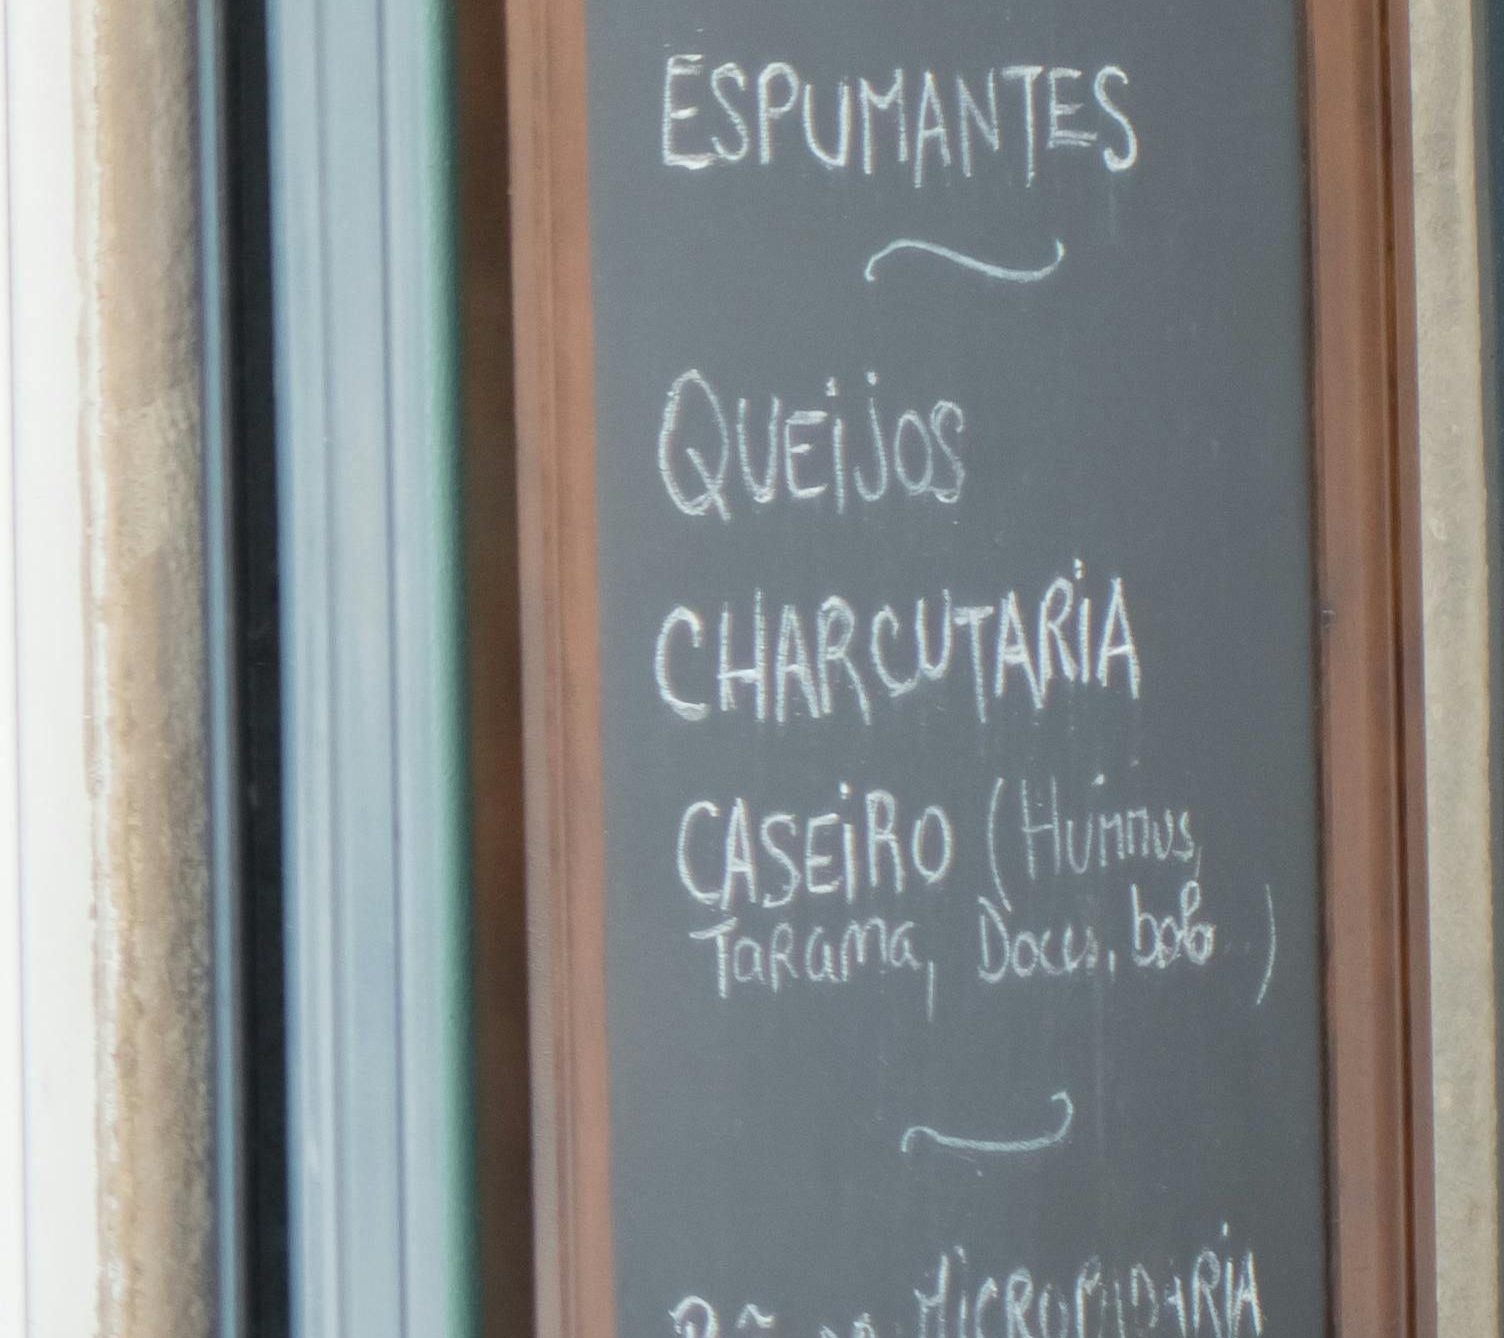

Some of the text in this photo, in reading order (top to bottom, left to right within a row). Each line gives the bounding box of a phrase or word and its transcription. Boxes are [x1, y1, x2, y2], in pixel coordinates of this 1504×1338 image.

[663, 54, 1139, 189] ESPUMANTES
[659, 368, 966, 521] QUEIJOS
[654, 558, 1141, 725] CHARCUTARIA
[677, 781, 954, 914] CASEIRO
